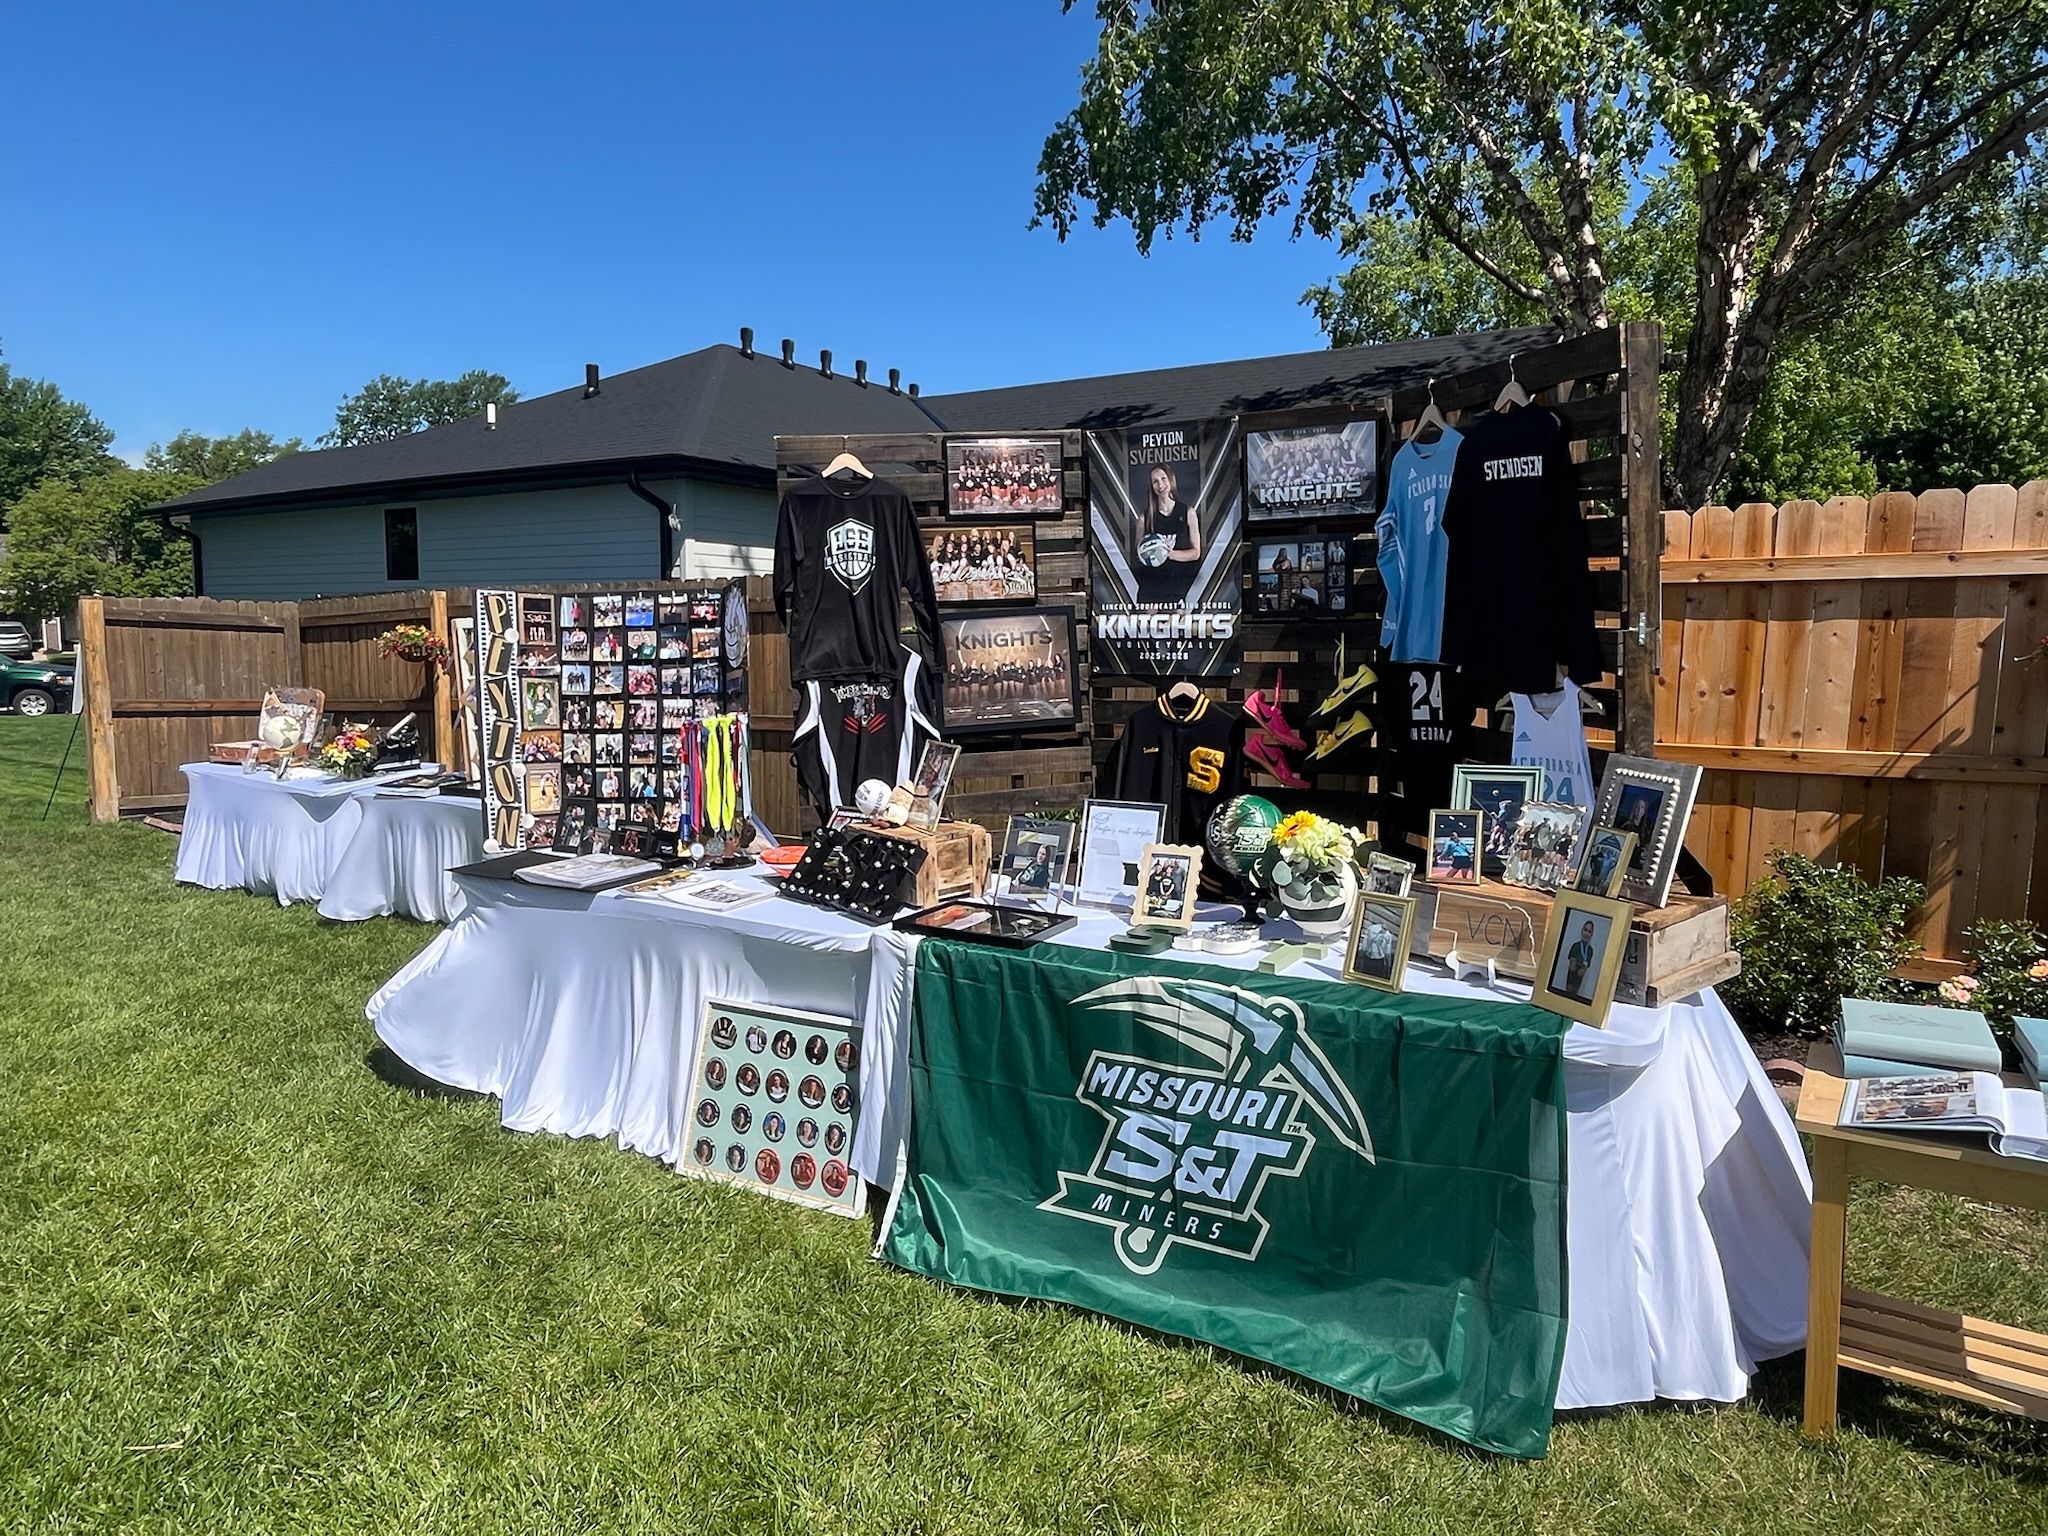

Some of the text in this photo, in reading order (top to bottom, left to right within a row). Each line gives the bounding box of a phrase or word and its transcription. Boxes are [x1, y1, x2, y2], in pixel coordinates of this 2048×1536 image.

[1129, 444, 1198, 465] SVENDSEN
[1142, 431, 1184, 448] PEYTON
[1483, 455, 1543, 481] SVENDSEN
[1259, 481, 1363, 504] KNIGHTS
[955, 630, 1053, 651] KNIGHTS
[1098, 613, 1234, 639] KNIGHTS
[1116, 641, 1214, 650] VOLLEYBALL
[1409, 671, 1444, 721] 24
[486, 594, 520, 848] PEYTON
[1187, 746, 1225, 794] S
[1466, 910, 1524, 951] VCN
[1087, 1061, 1289, 1132] MISSOURI
[1103, 1106, 1294, 1203] S&T
[1091, 1192, 1225, 1241] MINERS
